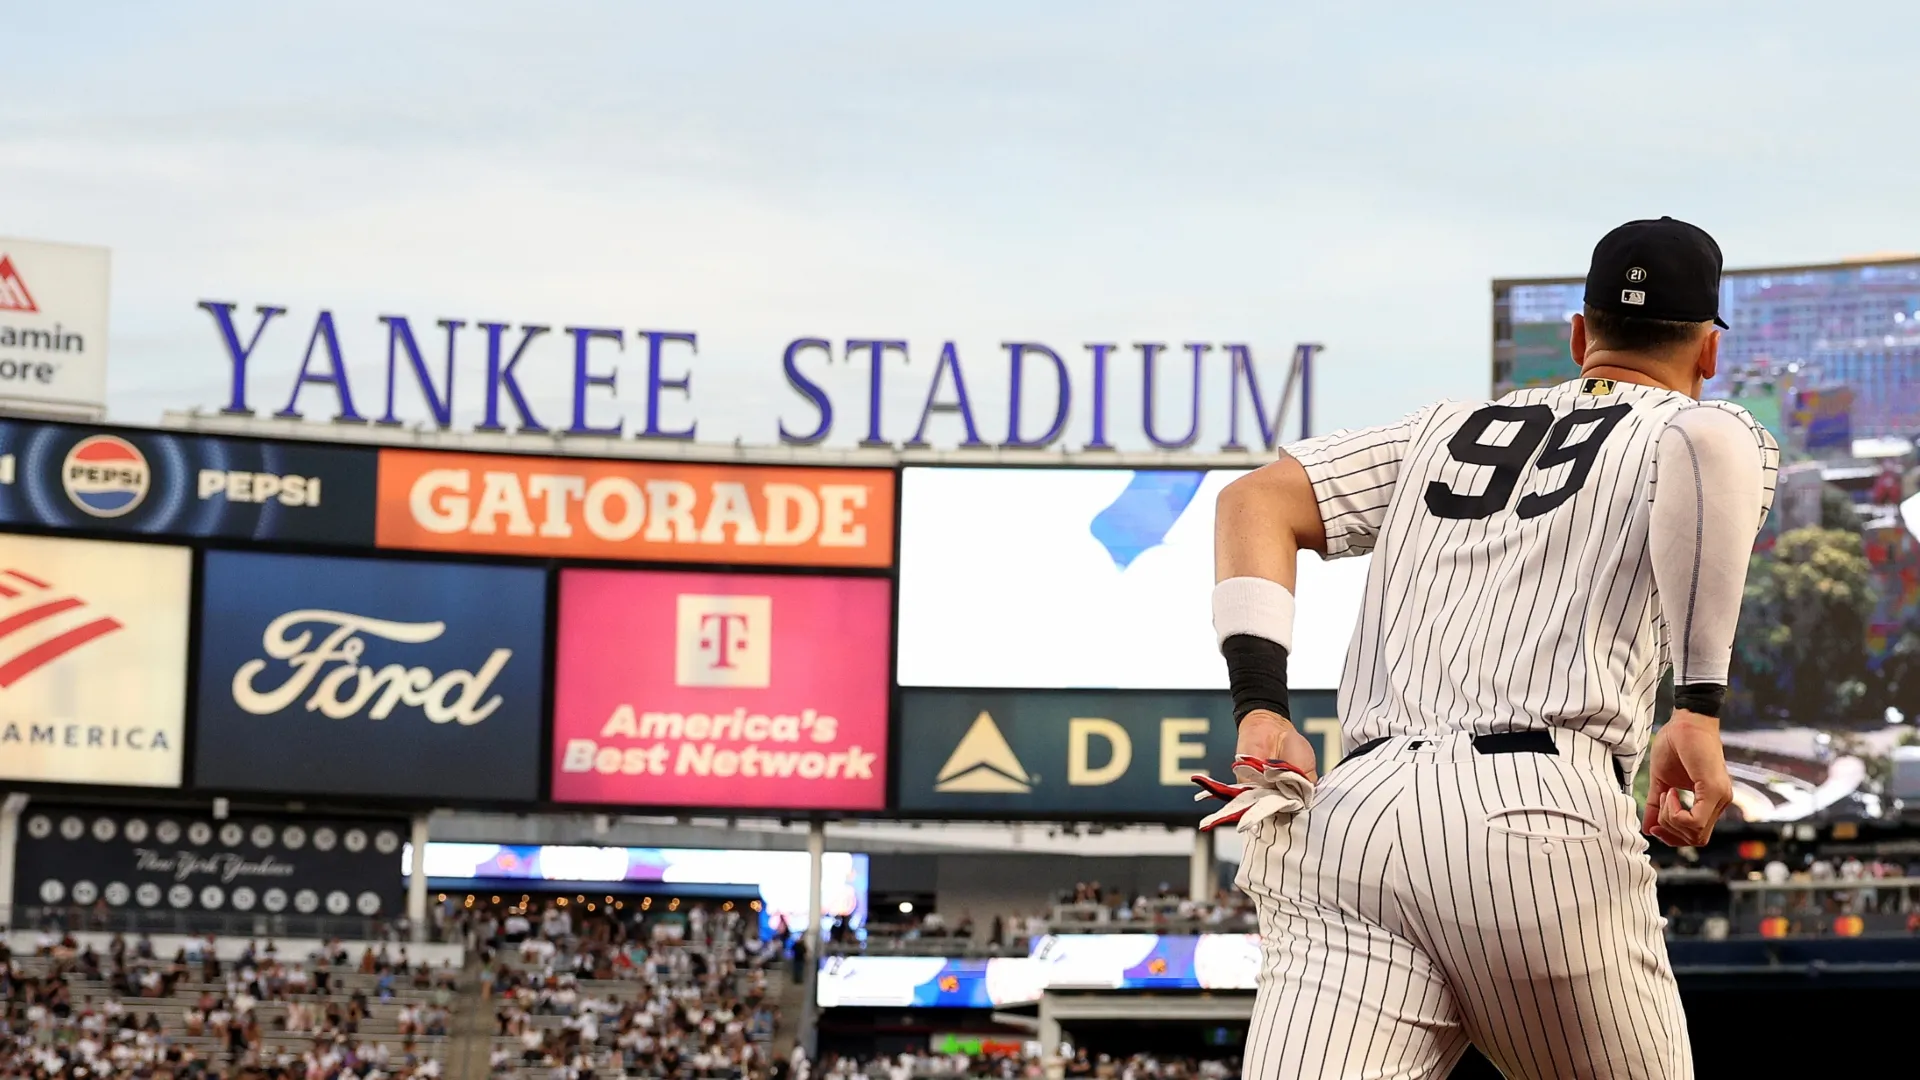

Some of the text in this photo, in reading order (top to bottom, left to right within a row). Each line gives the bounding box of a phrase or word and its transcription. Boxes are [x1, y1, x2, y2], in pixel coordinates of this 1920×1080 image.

[1630, 269, 1642, 280] 21
[0, 322, 84, 352] amin
[197, 300, 1326, 451] YANKEE STADIUM
[70, 466, 142, 486] PEPSI
[1424, 402, 1633, 520] 99
[198, 469, 321, 507] PEPSI
[409, 469, 868, 548] GATORADE
[700, 614, 748, 669] T
[232, 609, 512, 726] Ford
[2, 721, 169, 750] AMERICA
[601, 704, 838, 742] America's
[562, 739, 876, 779] Best Network
[1068, 717, 1341, 785] DET
